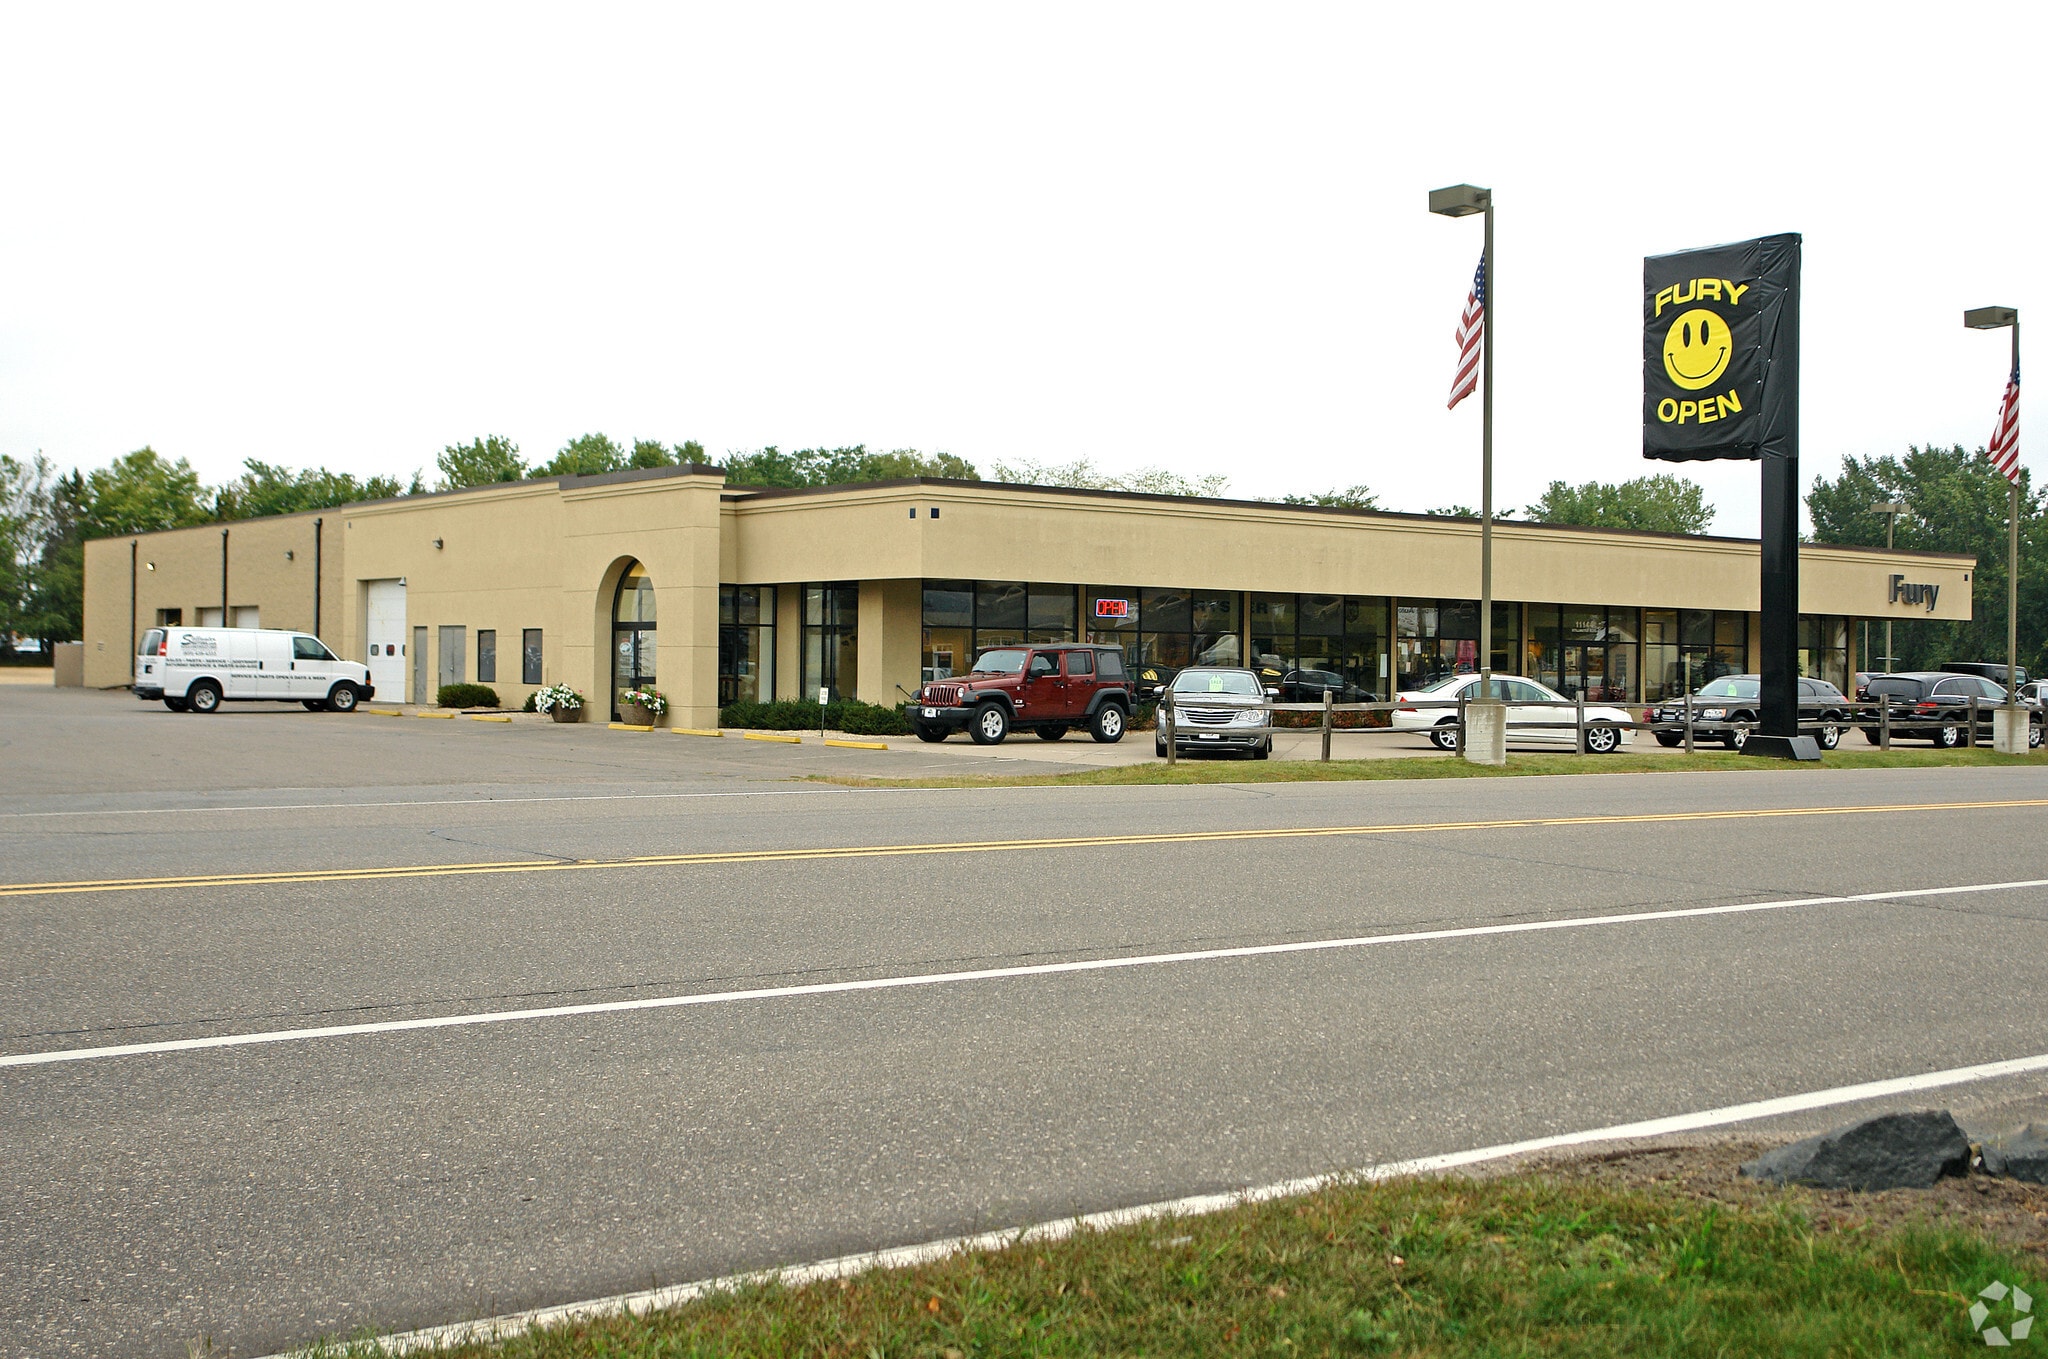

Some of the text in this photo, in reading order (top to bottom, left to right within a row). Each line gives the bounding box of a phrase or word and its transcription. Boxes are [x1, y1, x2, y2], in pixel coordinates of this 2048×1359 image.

[1655, 278, 1749, 318] FURY
[1657, 389, 1742, 424] OPEN
[1098, 601, 1126, 615] OPEN
[1889, 574, 1939, 612] Fury
